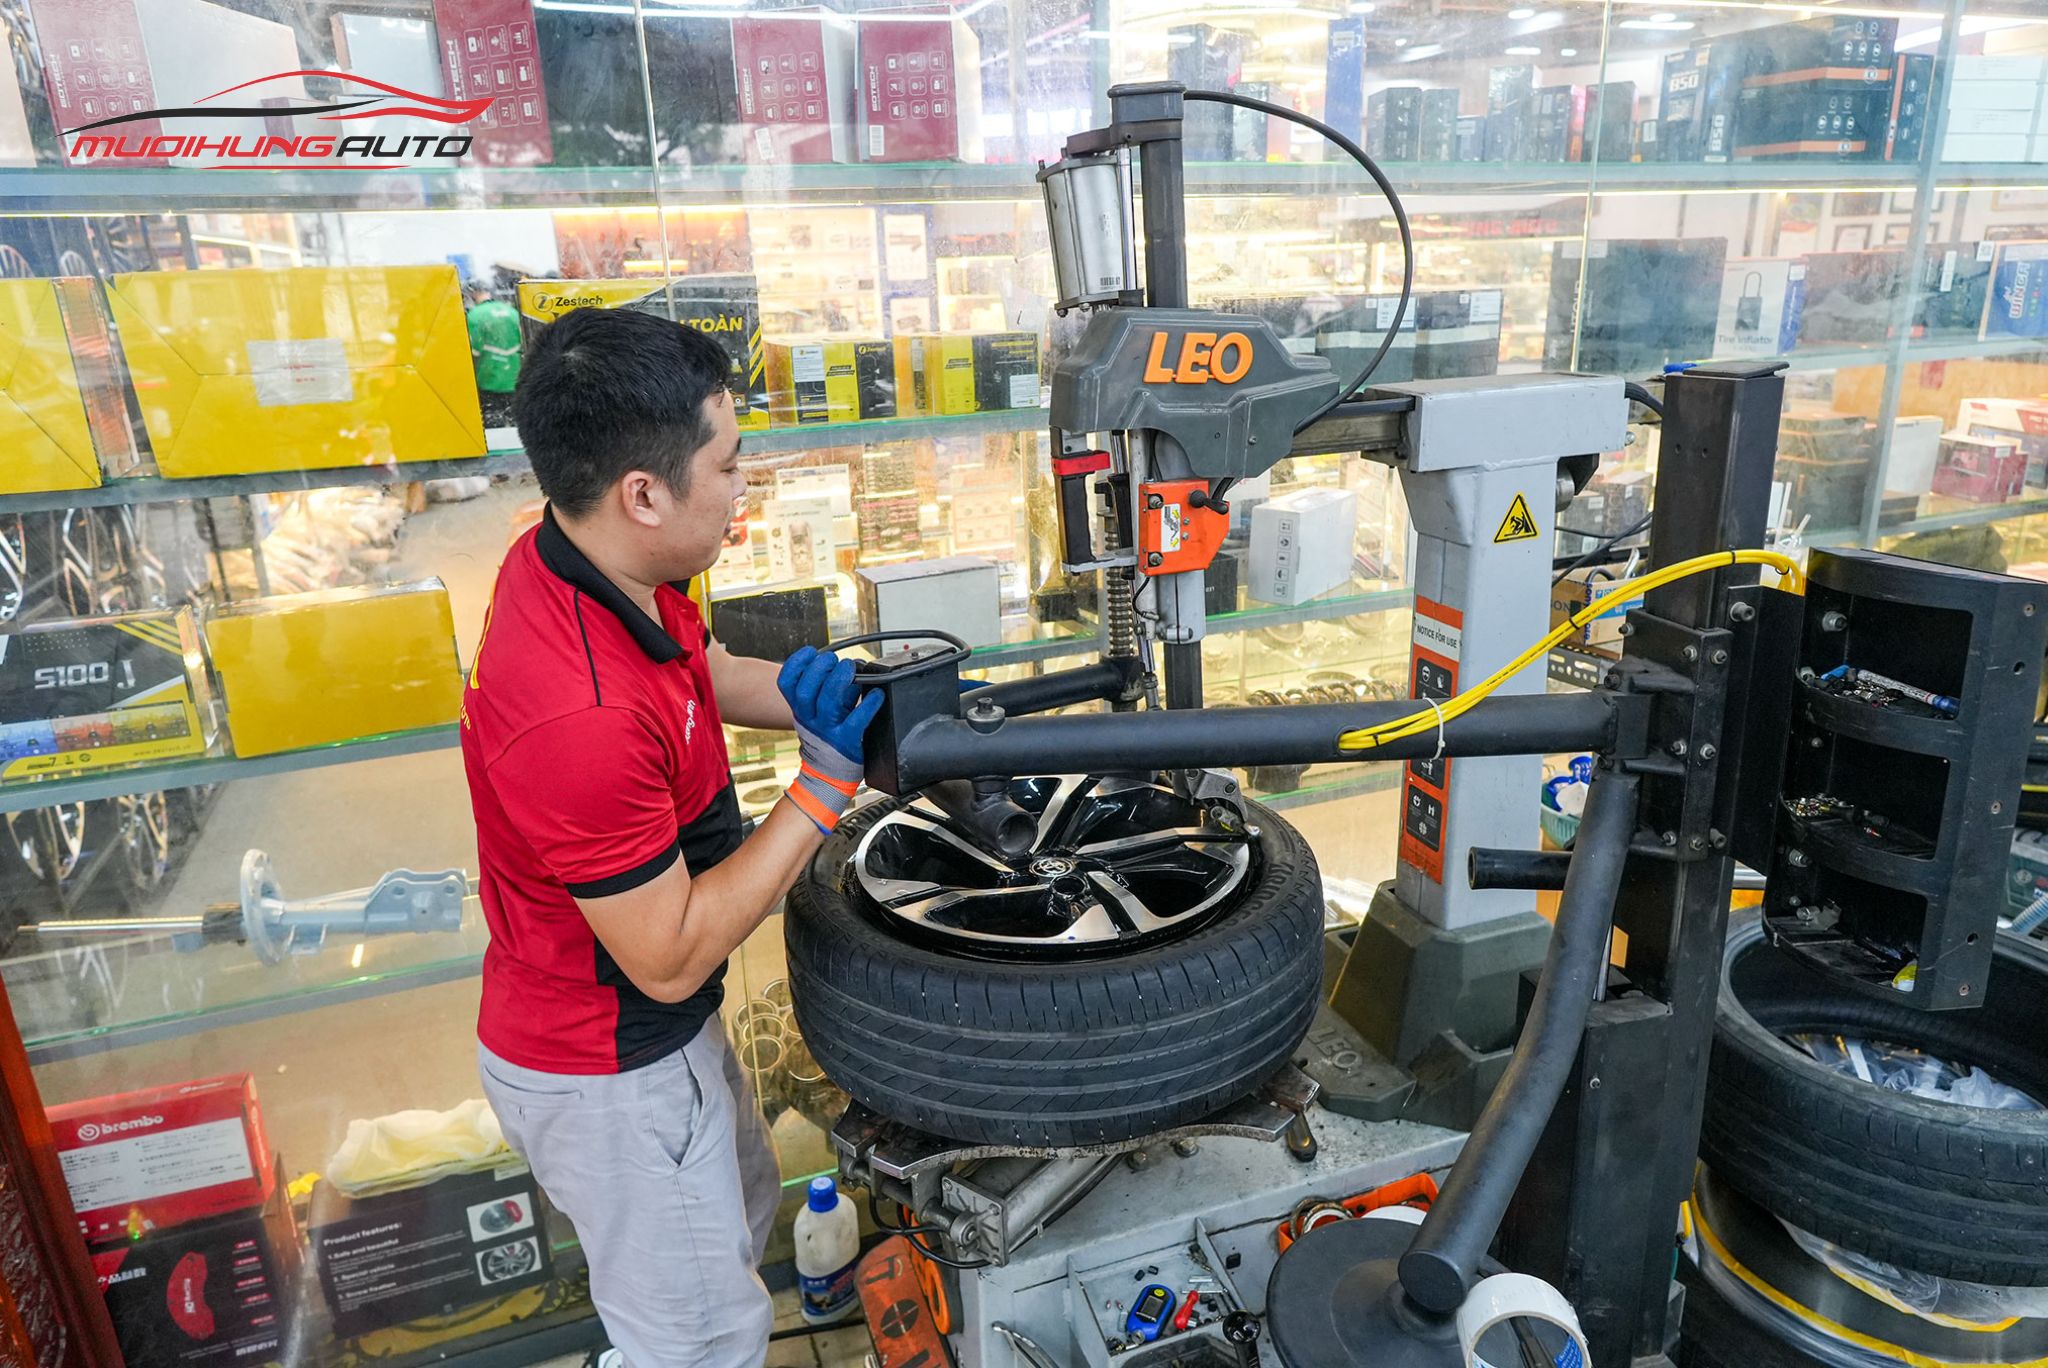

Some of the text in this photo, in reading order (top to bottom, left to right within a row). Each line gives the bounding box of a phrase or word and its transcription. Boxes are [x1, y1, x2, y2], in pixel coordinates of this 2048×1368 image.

[555, 295, 603, 307] Zestech
[1143, 332, 1254, 384] LEO
[1417, 624, 1458, 649] NOTICE FOR USE
[102, 1115, 164, 1135] brembo
